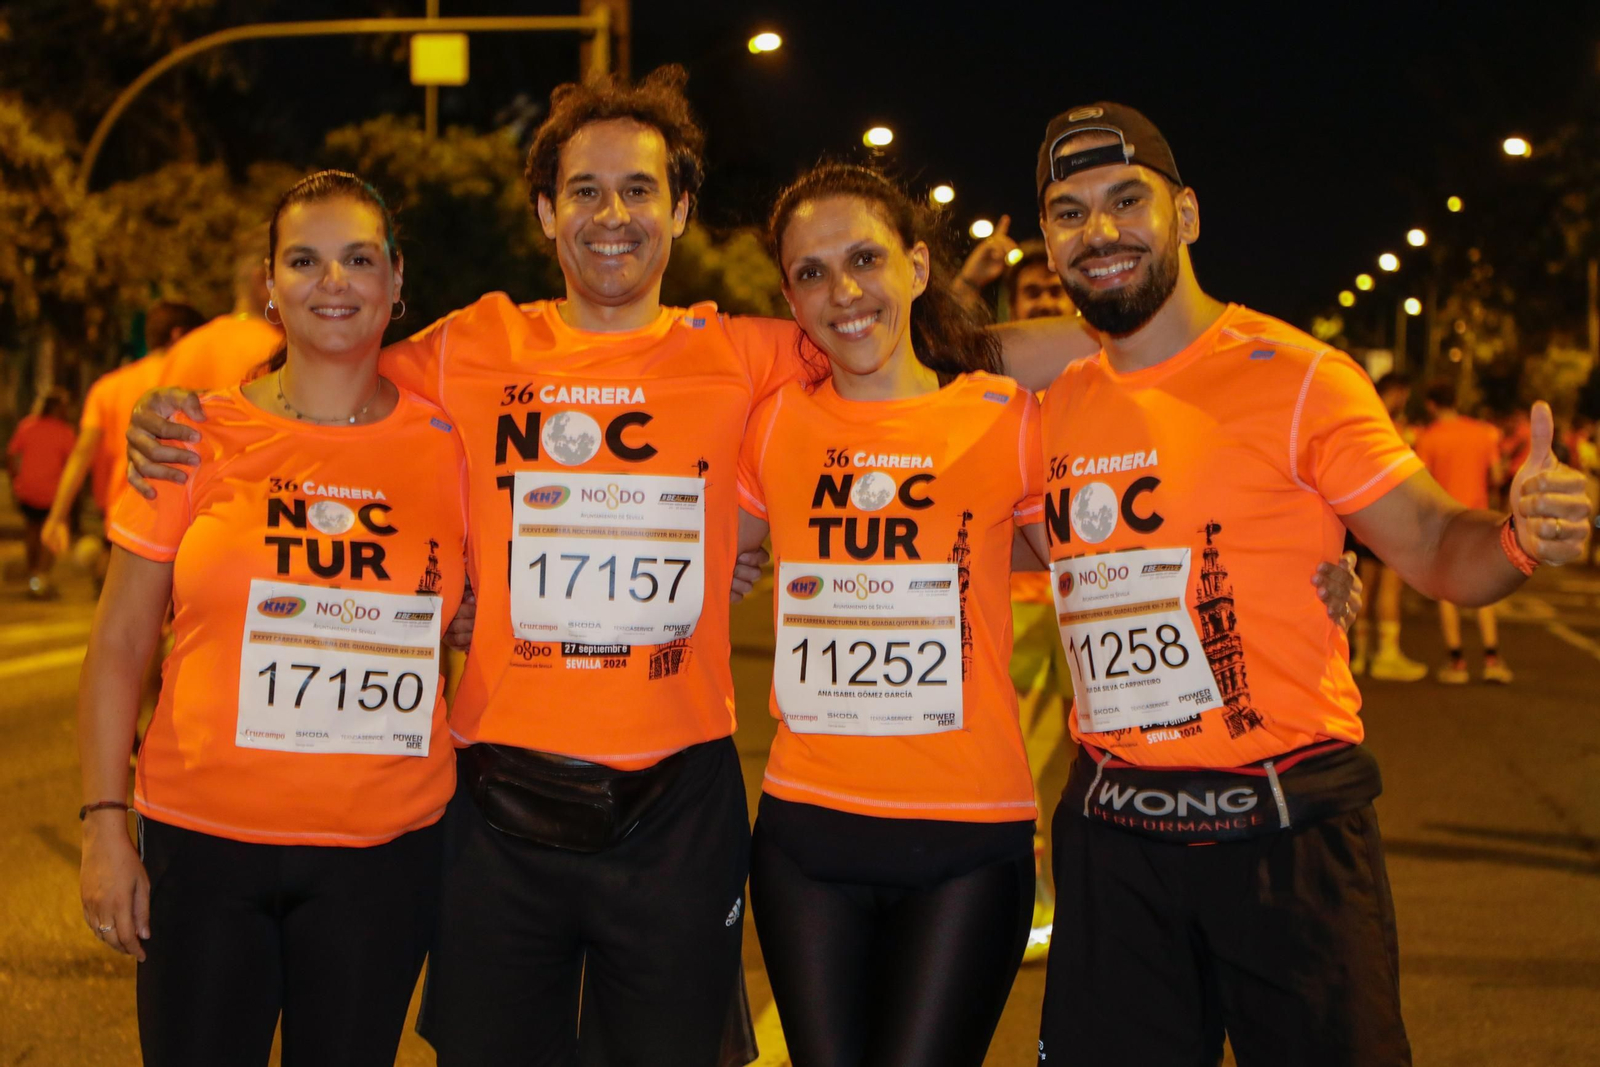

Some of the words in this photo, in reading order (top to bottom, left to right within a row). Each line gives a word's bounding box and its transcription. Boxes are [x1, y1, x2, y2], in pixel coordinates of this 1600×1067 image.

[500, 382, 534, 406] 36
[539, 385, 646, 404] CARRERA
[824, 449, 849, 468] 36
[853, 452, 933, 468] CARRERA
[1047, 454, 1069, 483] 36
[1071, 449, 1158, 477] CARRERA
[269, 478, 298, 493] 36
[302, 481, 386, 501] CARRERA
[542, 527, 571, 535] CARRERA
[808, 517, 921, 561] TUR
[264, 536, 391, 581] TUR
[529, 553, 692, 604] 17157
[519, 622, 558, 631] Cruzcampo
[339, 641, 350, 649] DEL
[564, 644, 576, 654] 27
[579, 645, 627, 656] septiembre
[1069, 623, 1190, 683] 11258
[566, 659, 602, 669] SEVILLA
[603, 659, 627, 668] 2024
[792, 638, 947, 687] 11252
[258, 660, 424, 713] 17150
[1102, 684, 1119, 692] SILVA
[1119, 678, 1161, 690] CARPINTEIRO
[245, 728, 286, 740] Cruzcampo
[393, 733, 423, 743] POWER
[1099, 779, 1258, 817] WONG
[1094, 806, 1265, 832] PERFORMANCE
